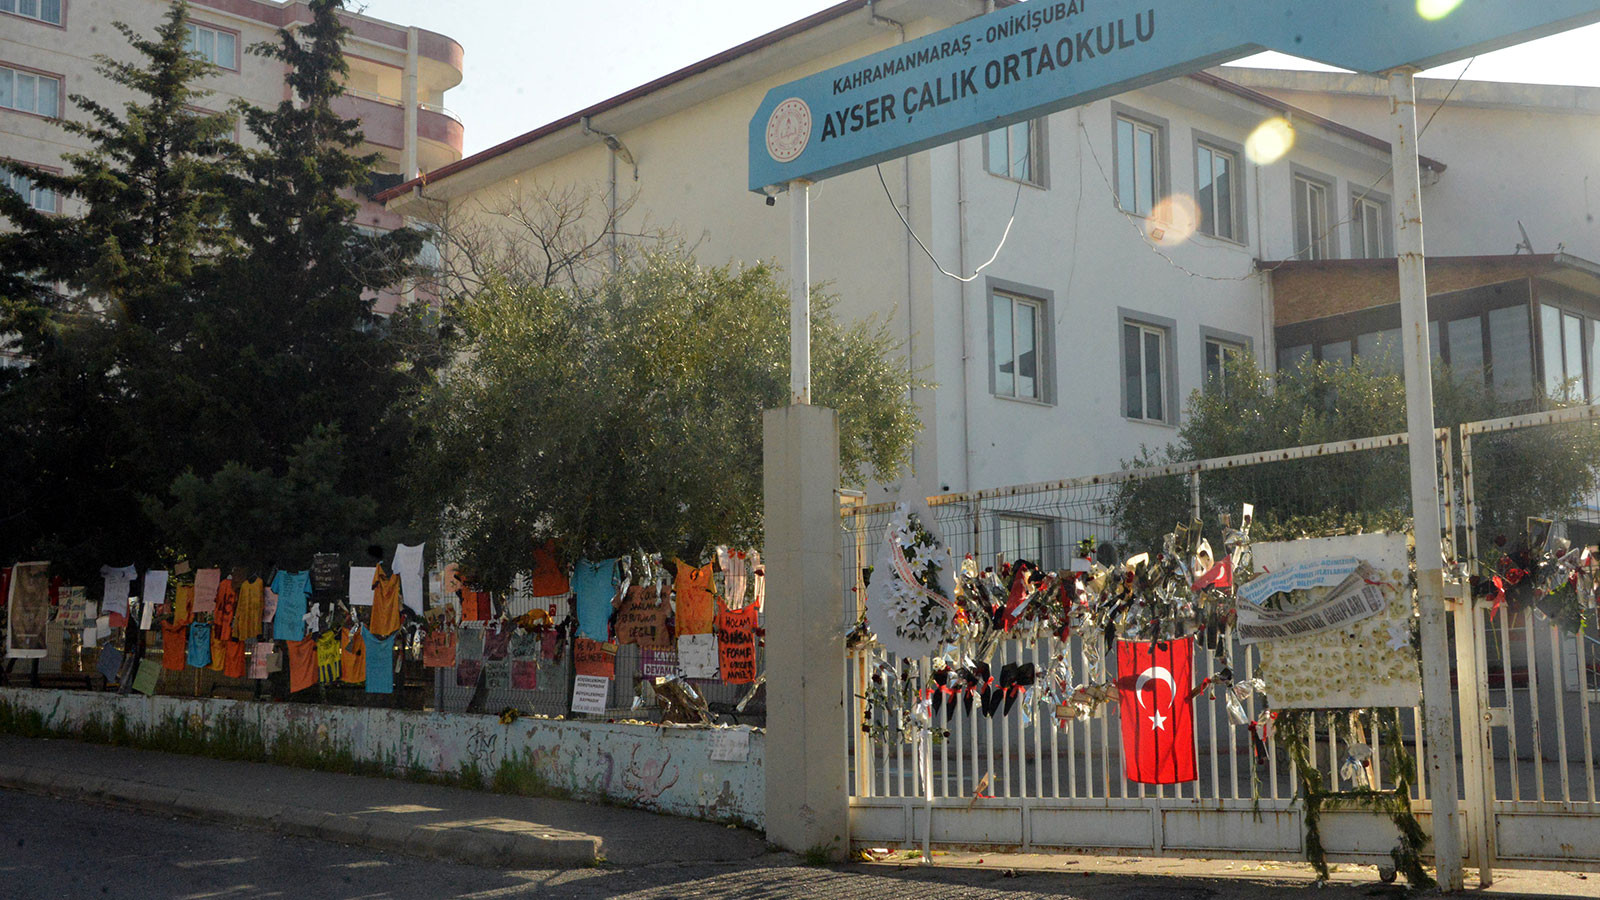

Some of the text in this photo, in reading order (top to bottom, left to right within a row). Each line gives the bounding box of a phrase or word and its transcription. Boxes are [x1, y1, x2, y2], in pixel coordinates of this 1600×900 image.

[820, 93, 896, 142] AYSER
[903, 65, 978, 123] ÇALIK
[984, 8, 1155, 89] ORTAOKULU
[832, 34, 971, 95] KAHRAMANMARAŞ
